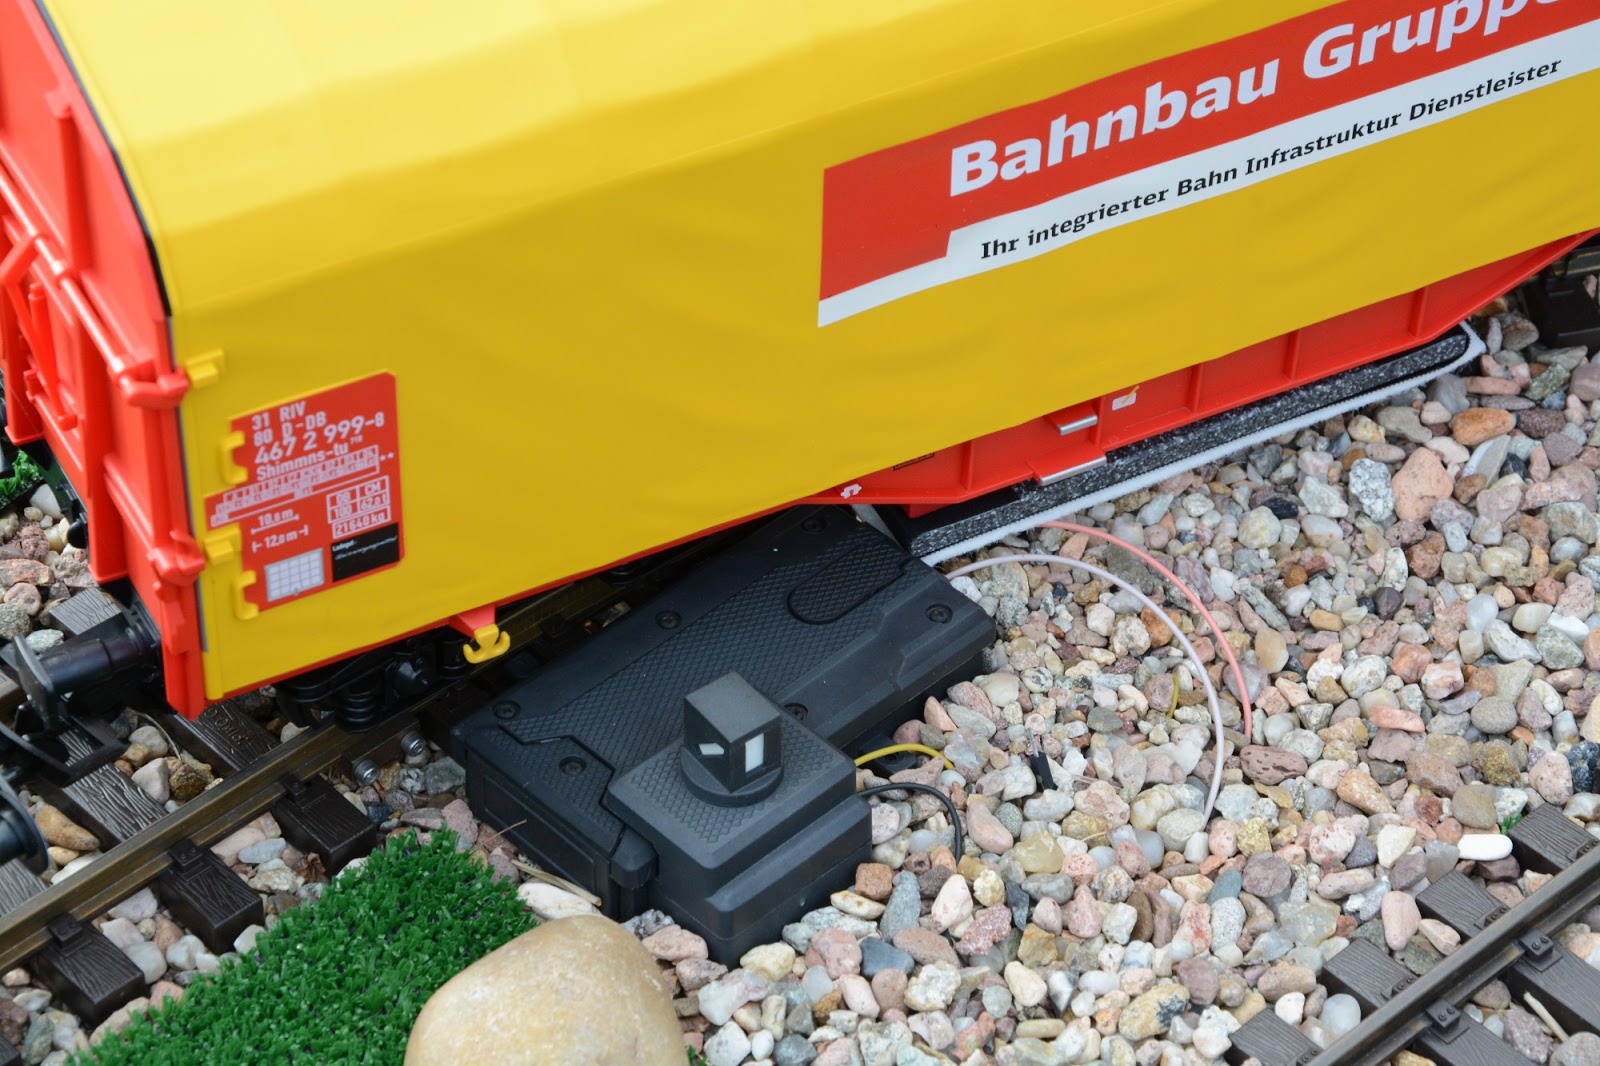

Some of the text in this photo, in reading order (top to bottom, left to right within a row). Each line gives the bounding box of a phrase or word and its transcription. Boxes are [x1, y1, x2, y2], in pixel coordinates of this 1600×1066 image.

[950, 0, 1557, 198] Bahnbau Grupp
[980, 58, 1563, 260] Ihr integrierter Bahn Infrastruktur Dienstleister
[251, 400, 306, 431] 31 RIV
[253, 427, 273, 447] 80
[254, 411, 385, 464] 467 2 999-8
[256, 443, 349, 482] Shimmns-tu
[334, 504, 352, 519] 100
